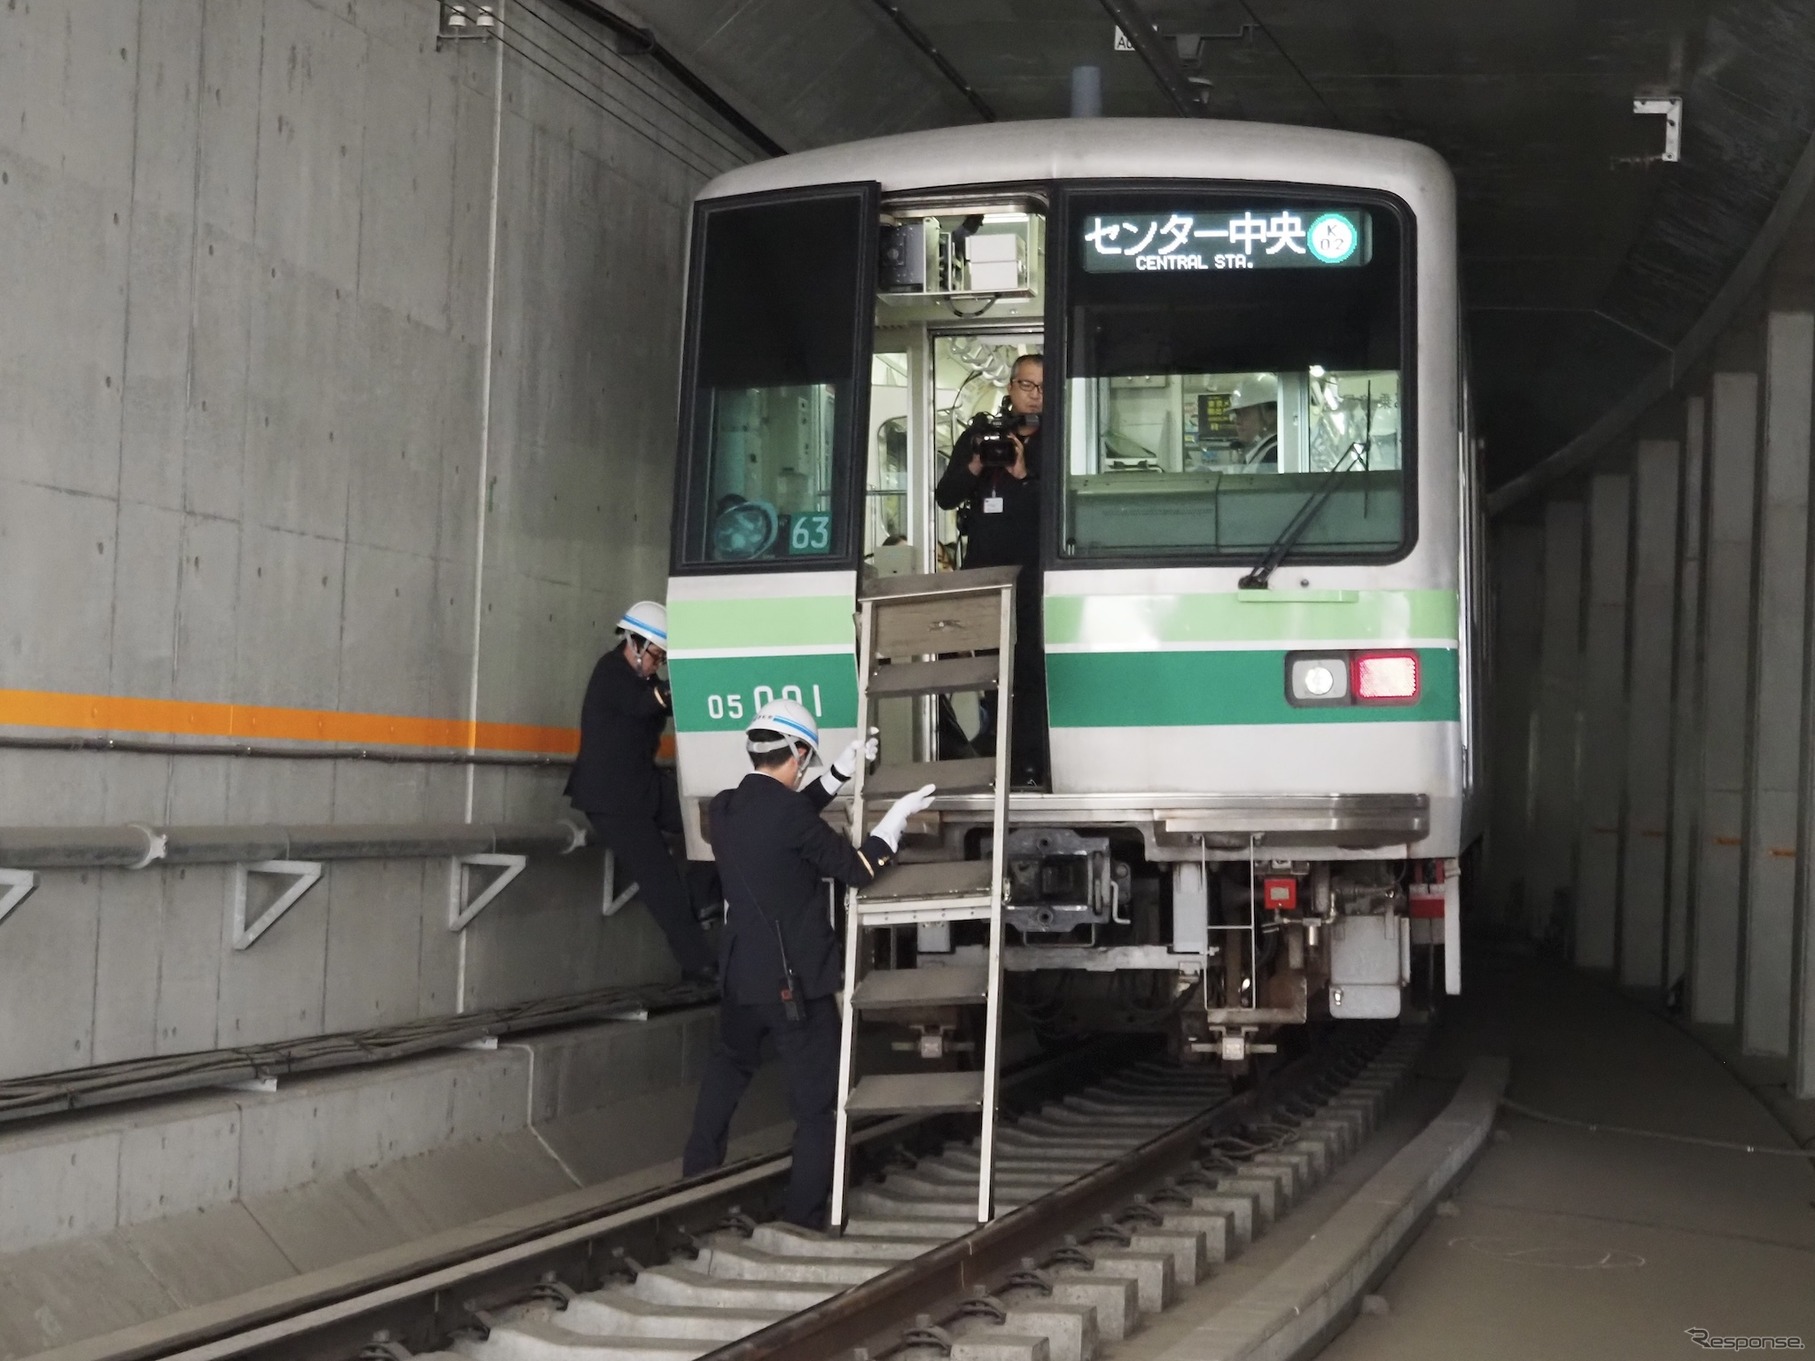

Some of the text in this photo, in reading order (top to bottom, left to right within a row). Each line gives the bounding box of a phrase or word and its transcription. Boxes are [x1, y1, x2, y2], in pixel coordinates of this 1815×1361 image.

[1084, 211, 1307, 255] センター中央
[1327, 224, 1338, 237] K
[1320, 238, 1345, 250] 02
[1135, 253, 1254, 271] CENTRAL STA.
[791, 516, 830, 549] 63
[707, 694, 744, 719] 05
